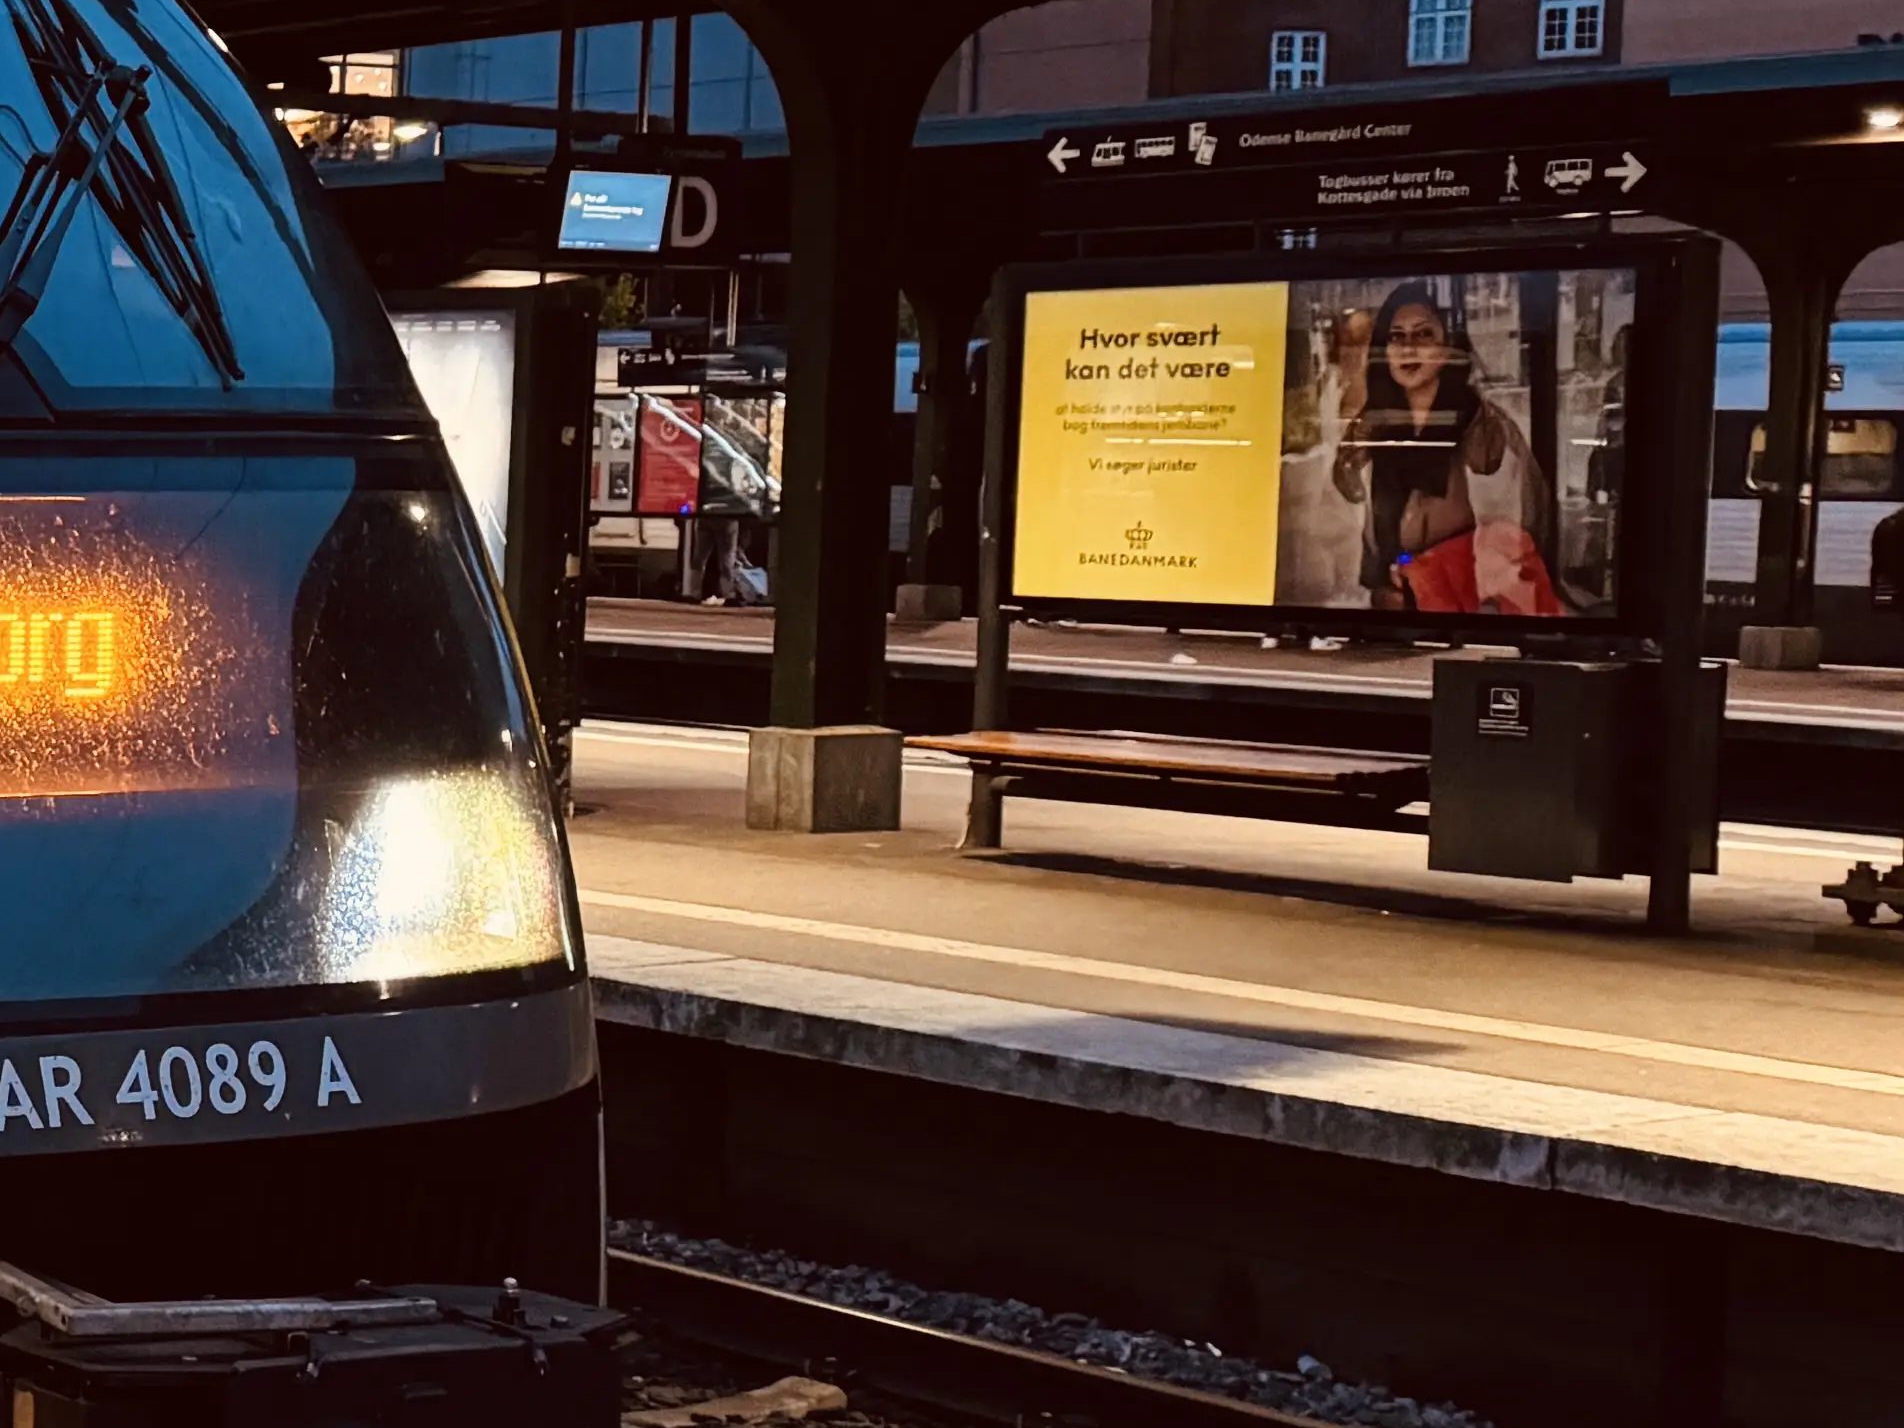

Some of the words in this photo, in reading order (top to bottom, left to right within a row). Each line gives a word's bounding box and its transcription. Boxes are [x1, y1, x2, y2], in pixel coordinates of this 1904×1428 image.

[1239, 132, 1291, 147] Odense
[1364, 123, 1412, 139] Center
[1318, 173, 1389, 189] Togbusser
[1435, 167, 1455, 181] fra
[1401, 185, 1422, 199] via
[670, 175, 718, 248] D
[1079, 328, 1140, 350] Hvor
[1145, 322, 1221, 348] svært
[1065, 358, 1110, 381] kan
[1117, 356, 1159, 379] det
[1165, 360, 1231, 378] være
[1088, 457, 1103, 471] Vi
[1079, 552, 1198, 568] BANEDANMARK
[115, 1040, 287, 1121] 4089
[316, 1035, 362, 1108] A
